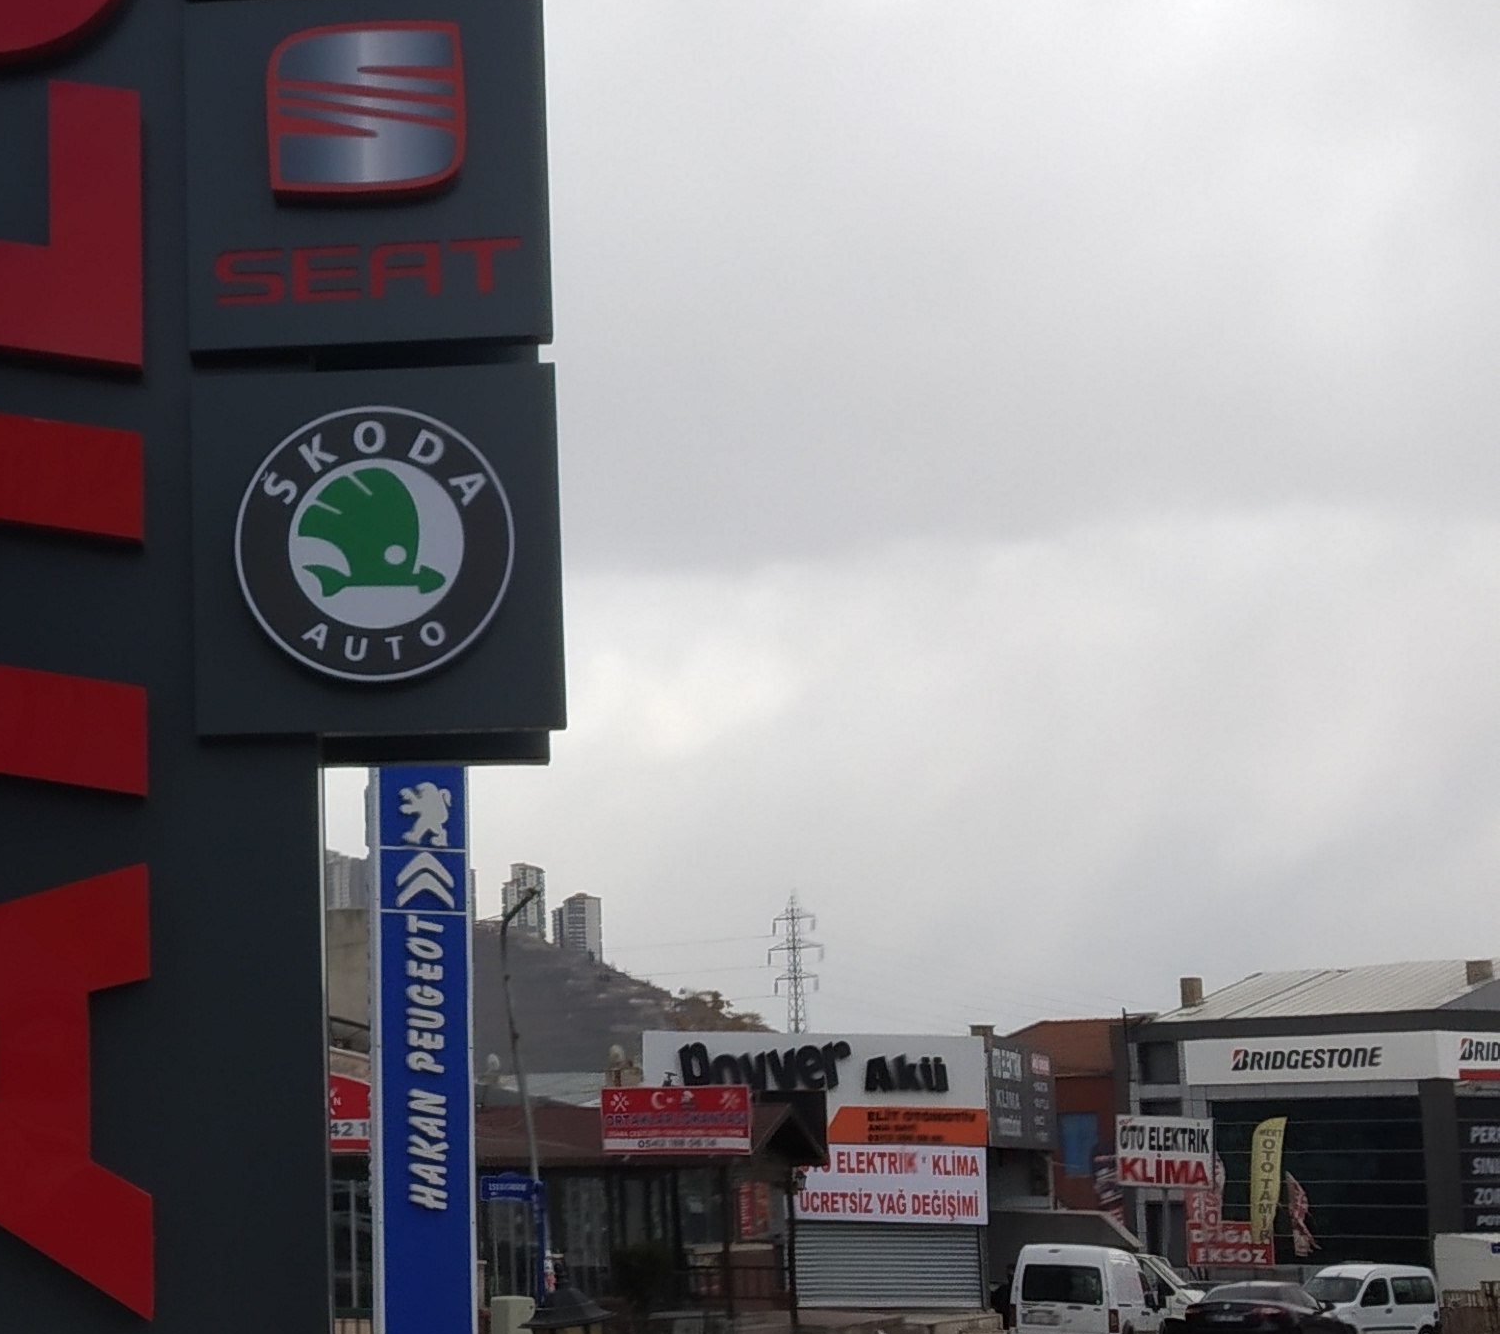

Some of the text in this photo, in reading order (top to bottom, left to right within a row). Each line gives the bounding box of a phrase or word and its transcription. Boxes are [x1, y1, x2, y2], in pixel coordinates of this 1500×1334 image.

[214, 235, 522, 307] SEAT
[301, 620, 447, 662] AUTO
[406, 914, 449, 1210] HAKAN PEUGEOT
[1231, 1046, 1383, 1072] BRIDGESTONE
[1119, 1121, 1210, 1154] OTO ELEKTRİK
[931, 1150, 980, 1177] KLİMA
[1120, 1153, 1209, 1186] KLİMA
[876, 1188, 908, 1216] YAĞ
[911, 1189, 980, 1222] DEĞİŞİMİ
[1196, 1247, 1268, 1264] EKSOZ
